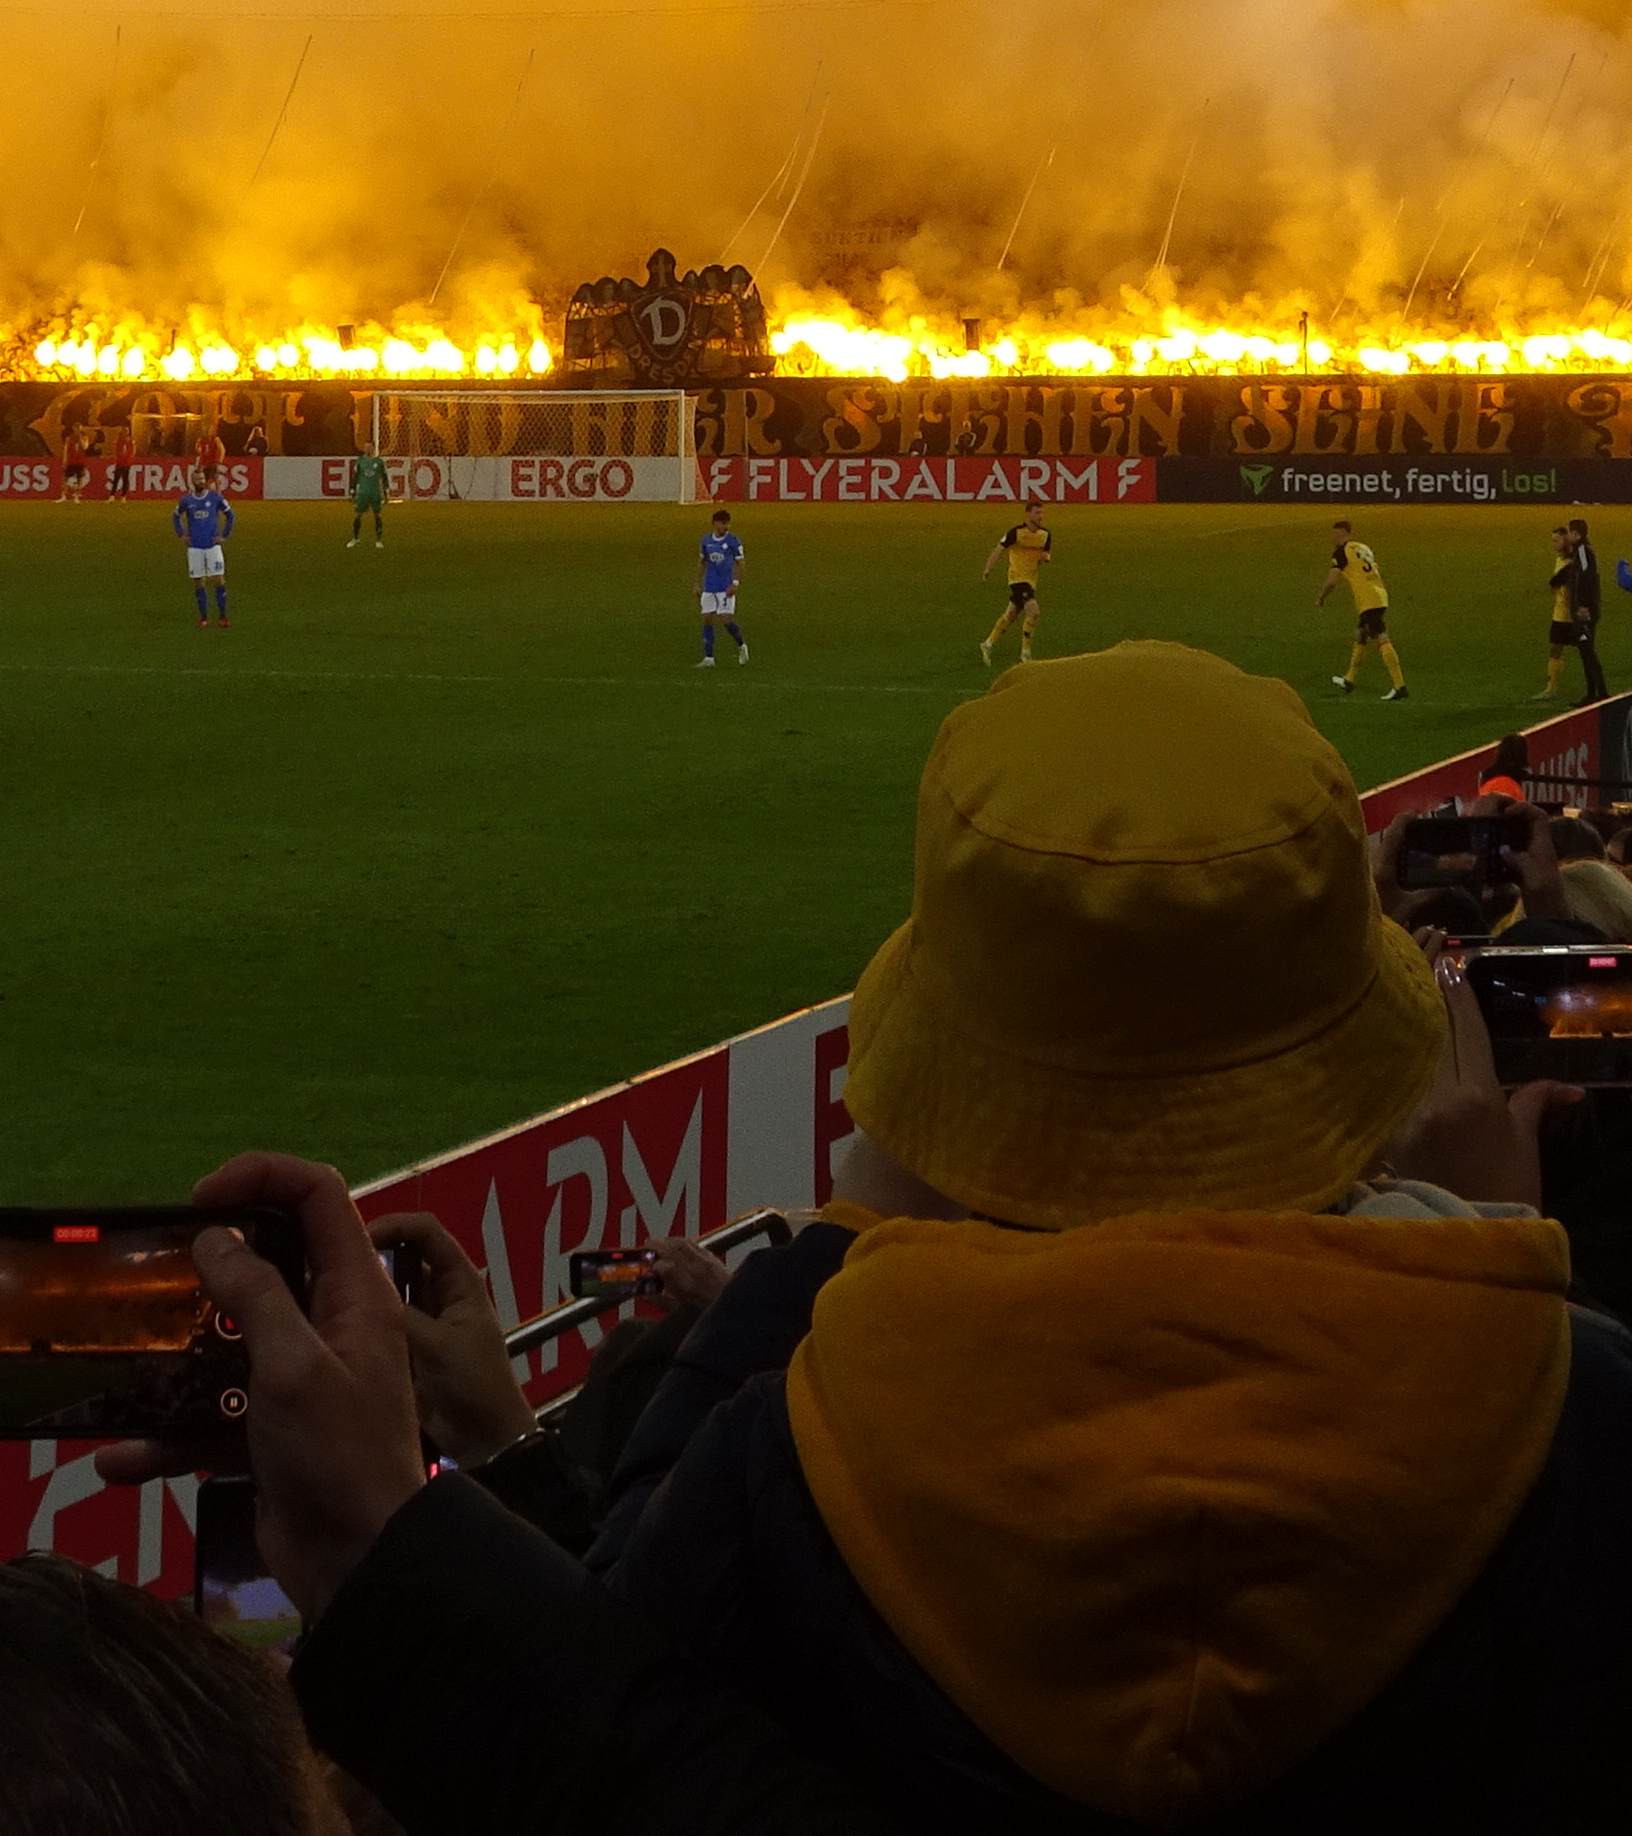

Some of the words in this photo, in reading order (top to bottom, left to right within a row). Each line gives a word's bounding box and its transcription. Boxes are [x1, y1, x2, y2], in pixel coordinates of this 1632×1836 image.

[640, 296, 686, 346] D
[822, 385, 1185, 456] STEHEN
[1230, 383, 1515, 455] SEINE
[321, 458, 442, 498] EGO
[510, 459, 634, 498] ERGO
[748, 458, 1099, 502] FLYERALARM
[1280, 467, 1402, 499] freenet,
[1405, 467, 1497, 500] fertig,
